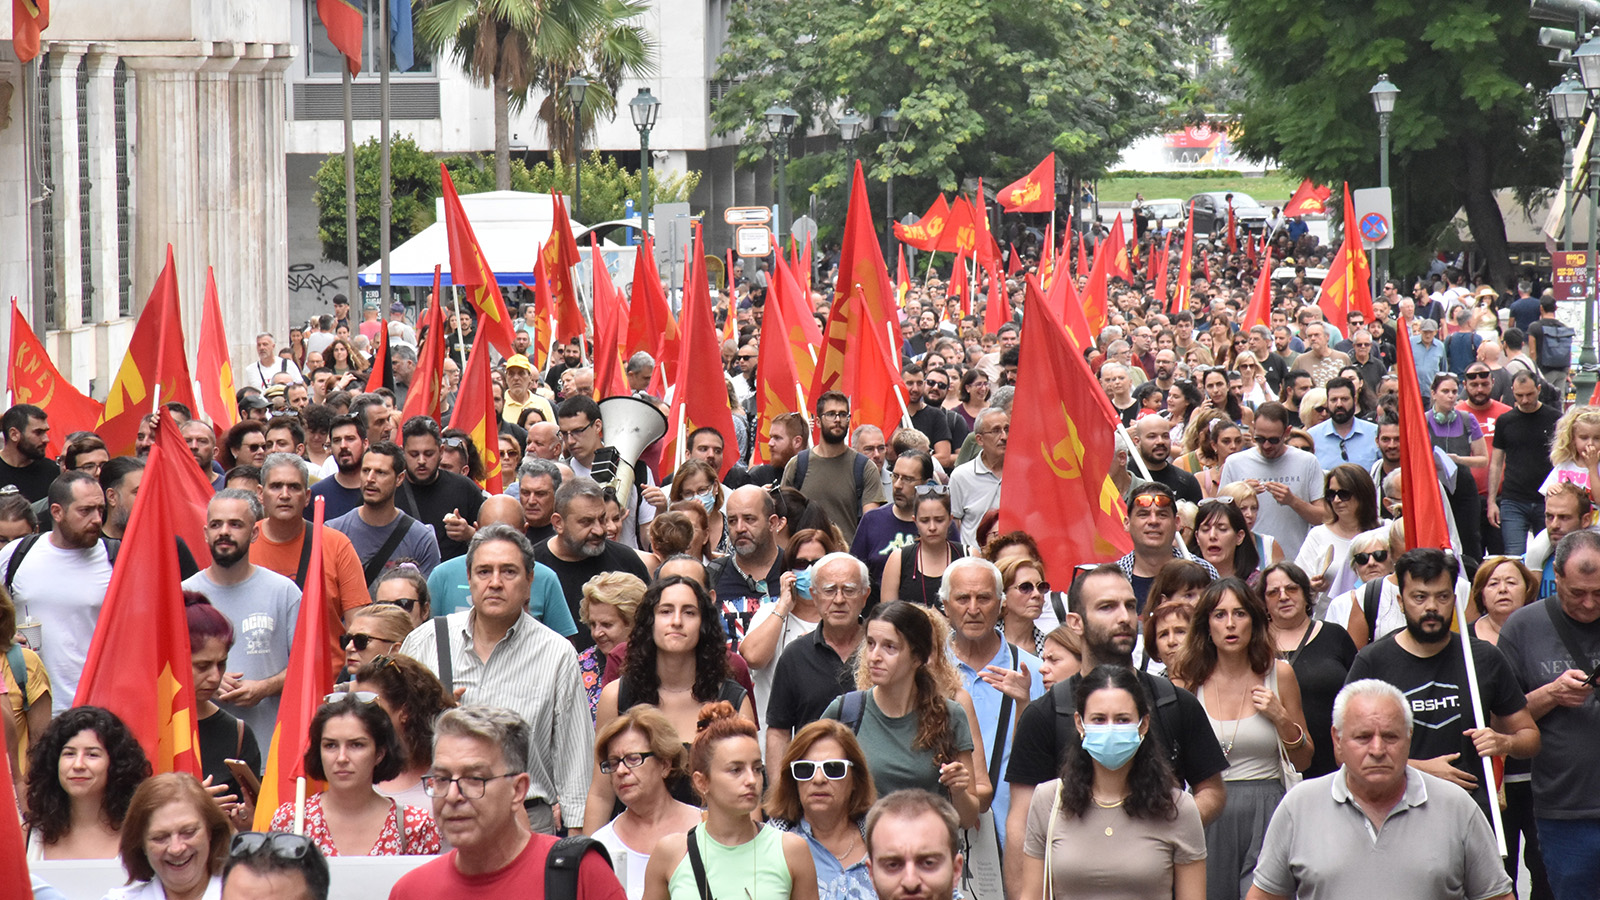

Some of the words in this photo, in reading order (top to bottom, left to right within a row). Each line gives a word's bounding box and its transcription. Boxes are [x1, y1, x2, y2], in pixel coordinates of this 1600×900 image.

[365, 290, 380, 298] ZERO
[1571, 286, 1581, 294] 14
[15, 341, 52, 388] KNE
[241, 615, 274, 634] ACME
[1411, 695, 1461, 712] BSHT.
